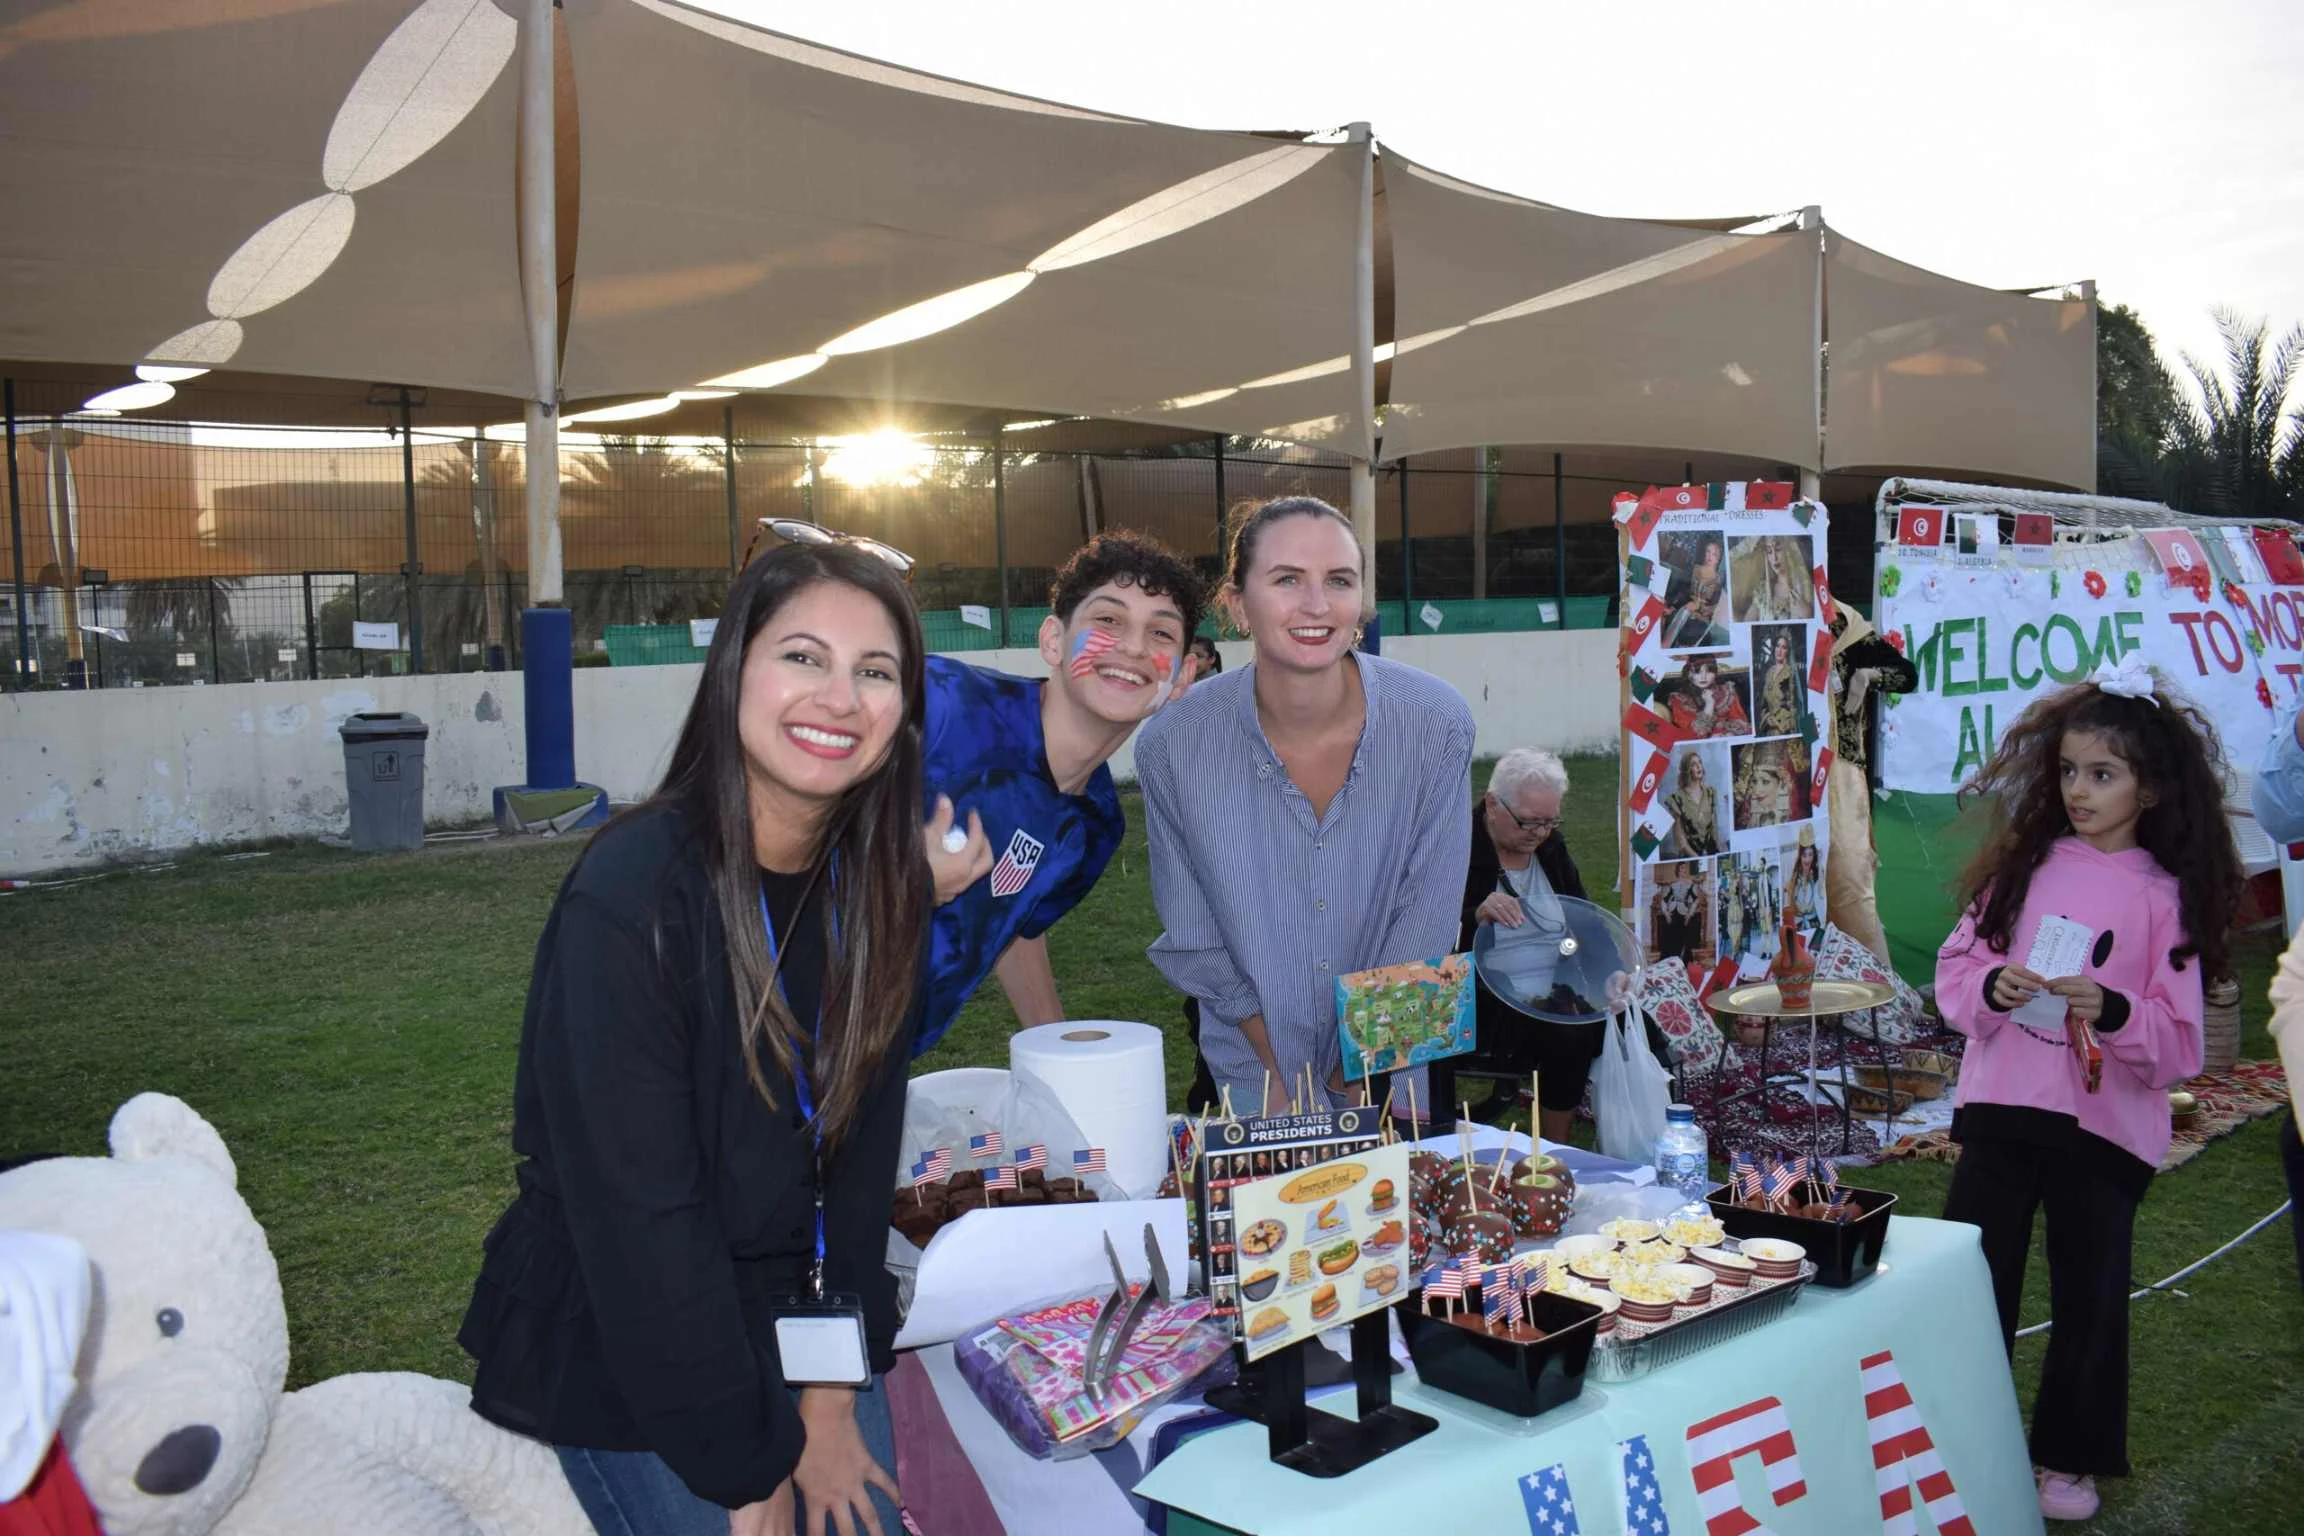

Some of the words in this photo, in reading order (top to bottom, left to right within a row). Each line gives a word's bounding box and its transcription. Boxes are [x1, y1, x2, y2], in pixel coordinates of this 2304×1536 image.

[1903, 611, 2144, 697] WELCOME
[2168, 610, 2244, 676] TO
[1011, 833, 1041, 866] USA
[1250, 1118, 1290, 1131] UNITED
[1293, 1113, 1332, 1127] STATES
[1250, 1124, 1332, 1142] PRESIDENTS
